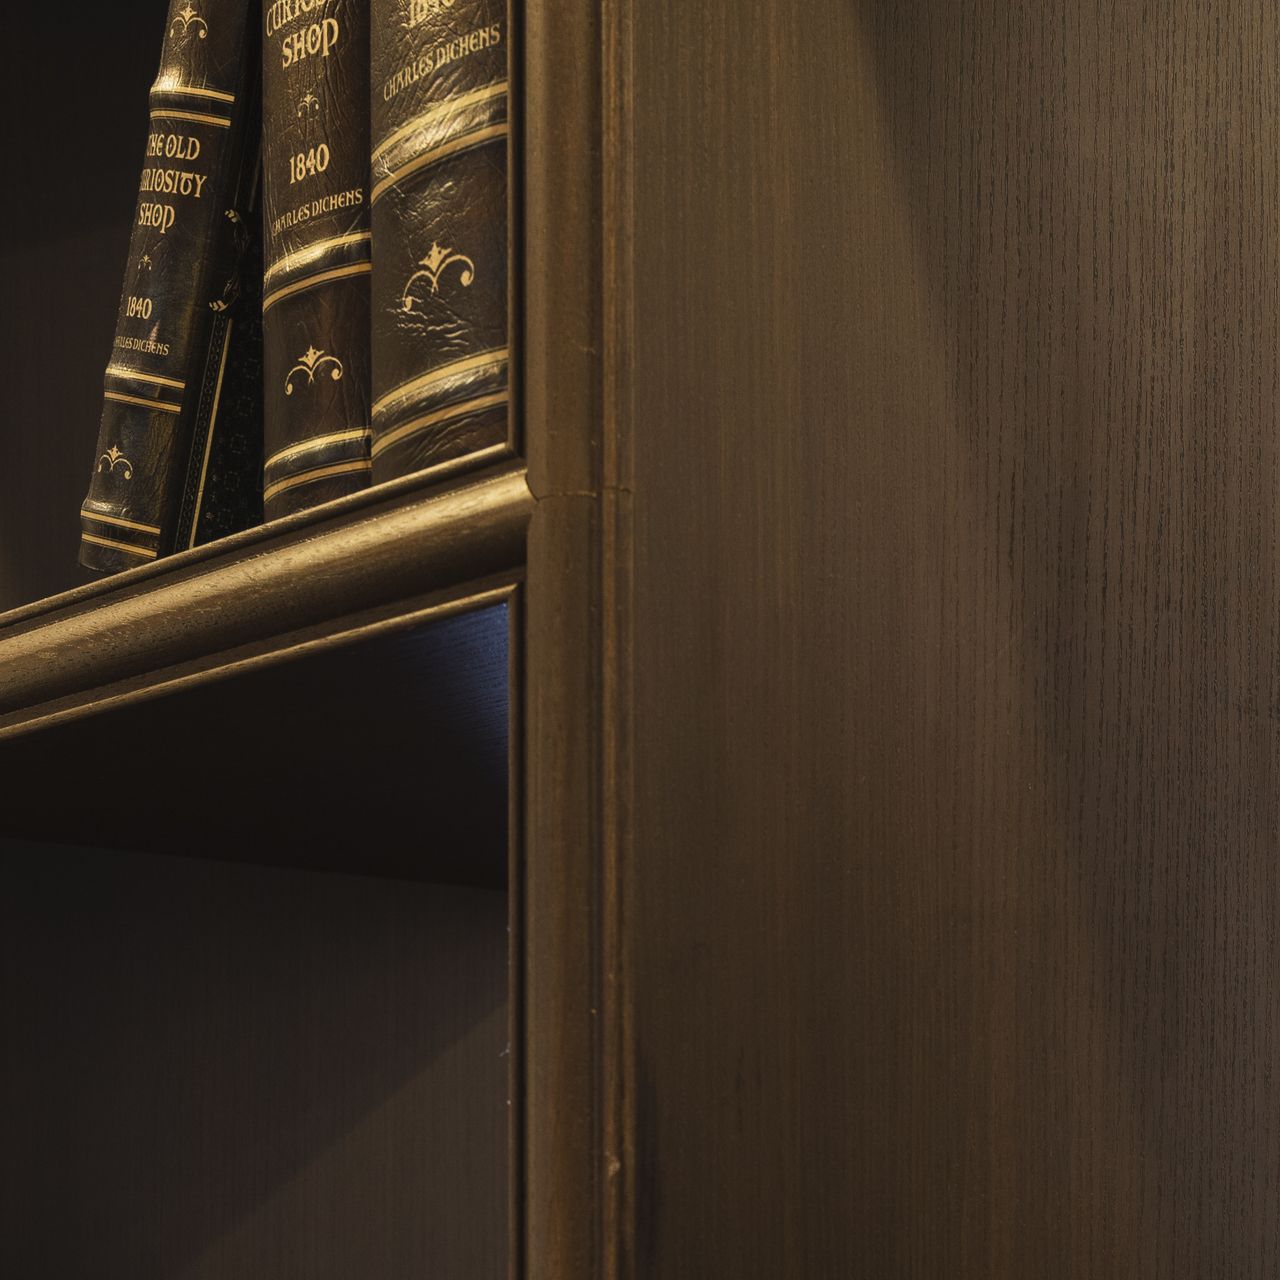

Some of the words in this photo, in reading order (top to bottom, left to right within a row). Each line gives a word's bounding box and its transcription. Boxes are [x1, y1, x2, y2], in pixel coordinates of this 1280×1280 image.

[282, 18, 338, 70] SHOP
[383, 51, 433, 102] CHARLES
[434, 24, 501, 68] DICHENS
[165, 134, 200, 160] OLD
[289, 143, 329, 184] 1840
[138, 202, 175, 234] SHOP
[312, 188, 363, 217] DICHENS
[126, 296, 152, 319] 1840
